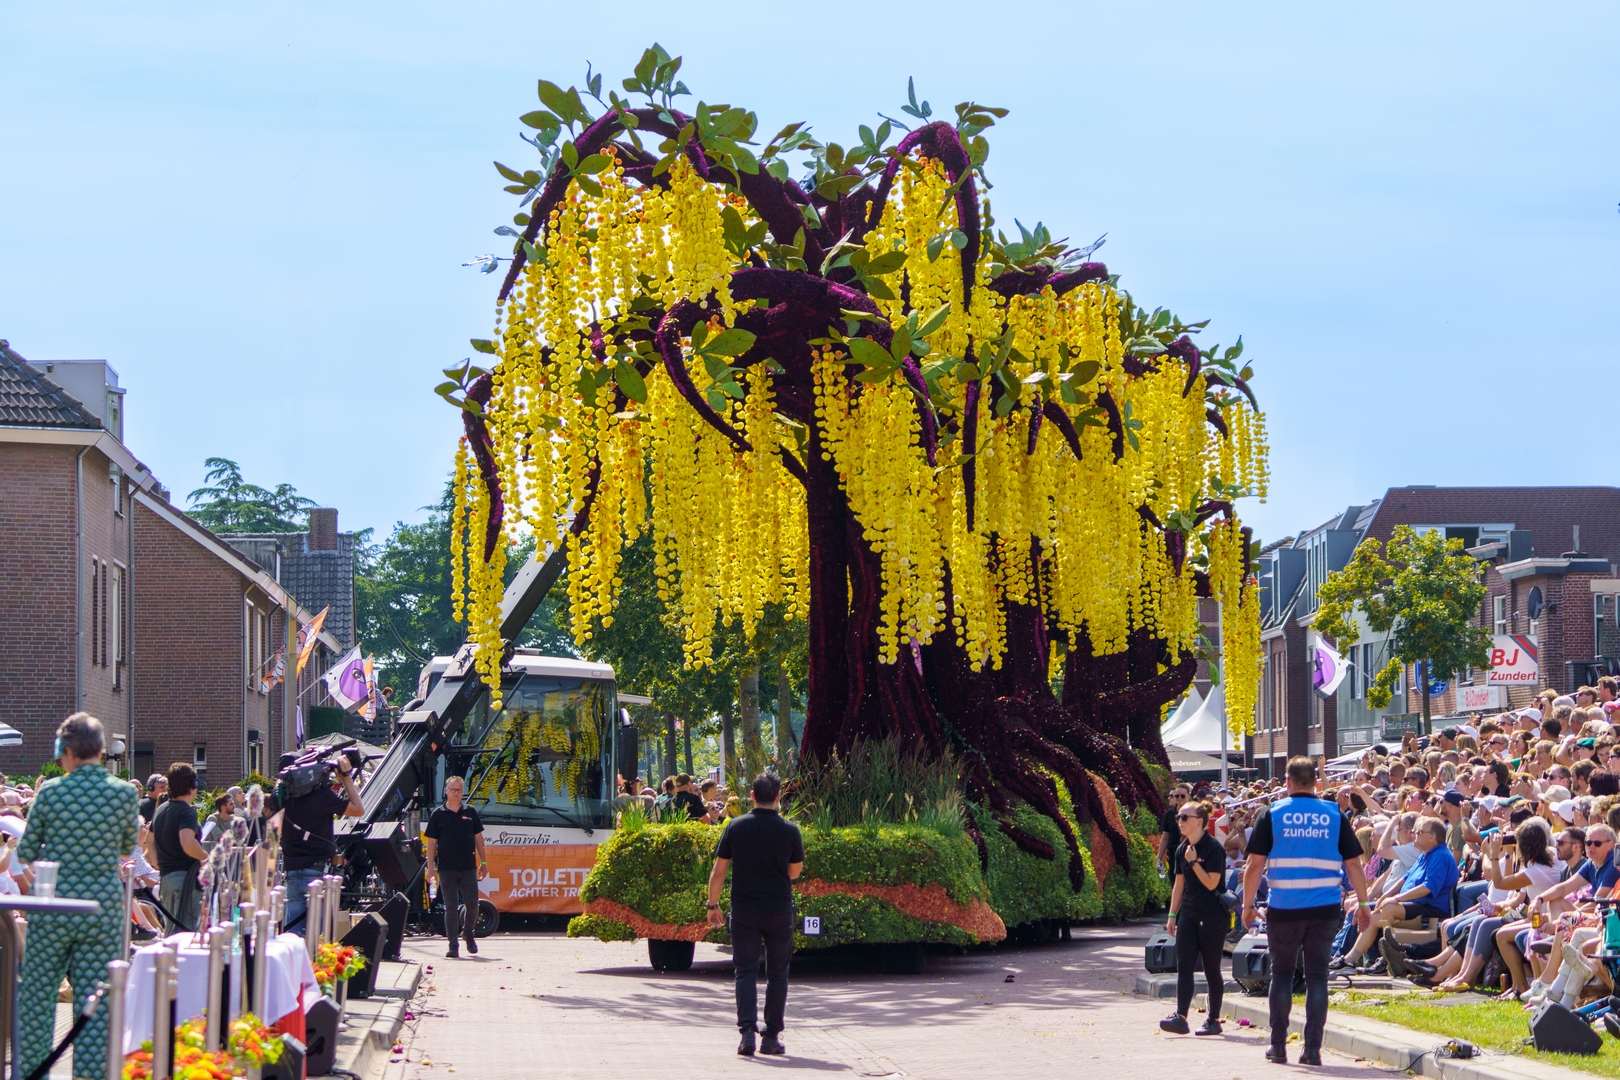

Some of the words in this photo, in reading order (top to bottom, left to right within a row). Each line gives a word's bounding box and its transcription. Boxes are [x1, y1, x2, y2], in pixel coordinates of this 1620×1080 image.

[1490, 648, 1519, 667] BJ
[1490, 671, 1536, 681] Zundert
[1282, 812, 1330, 826] corso
[1283, 826, 1330, 839] zundert
[509, 868, 591, 886] TOILETT
[509, 887, 559, 898] ACHTER
[562, 887, 581, 898] TR
[806, 919, 818, 928] 16
